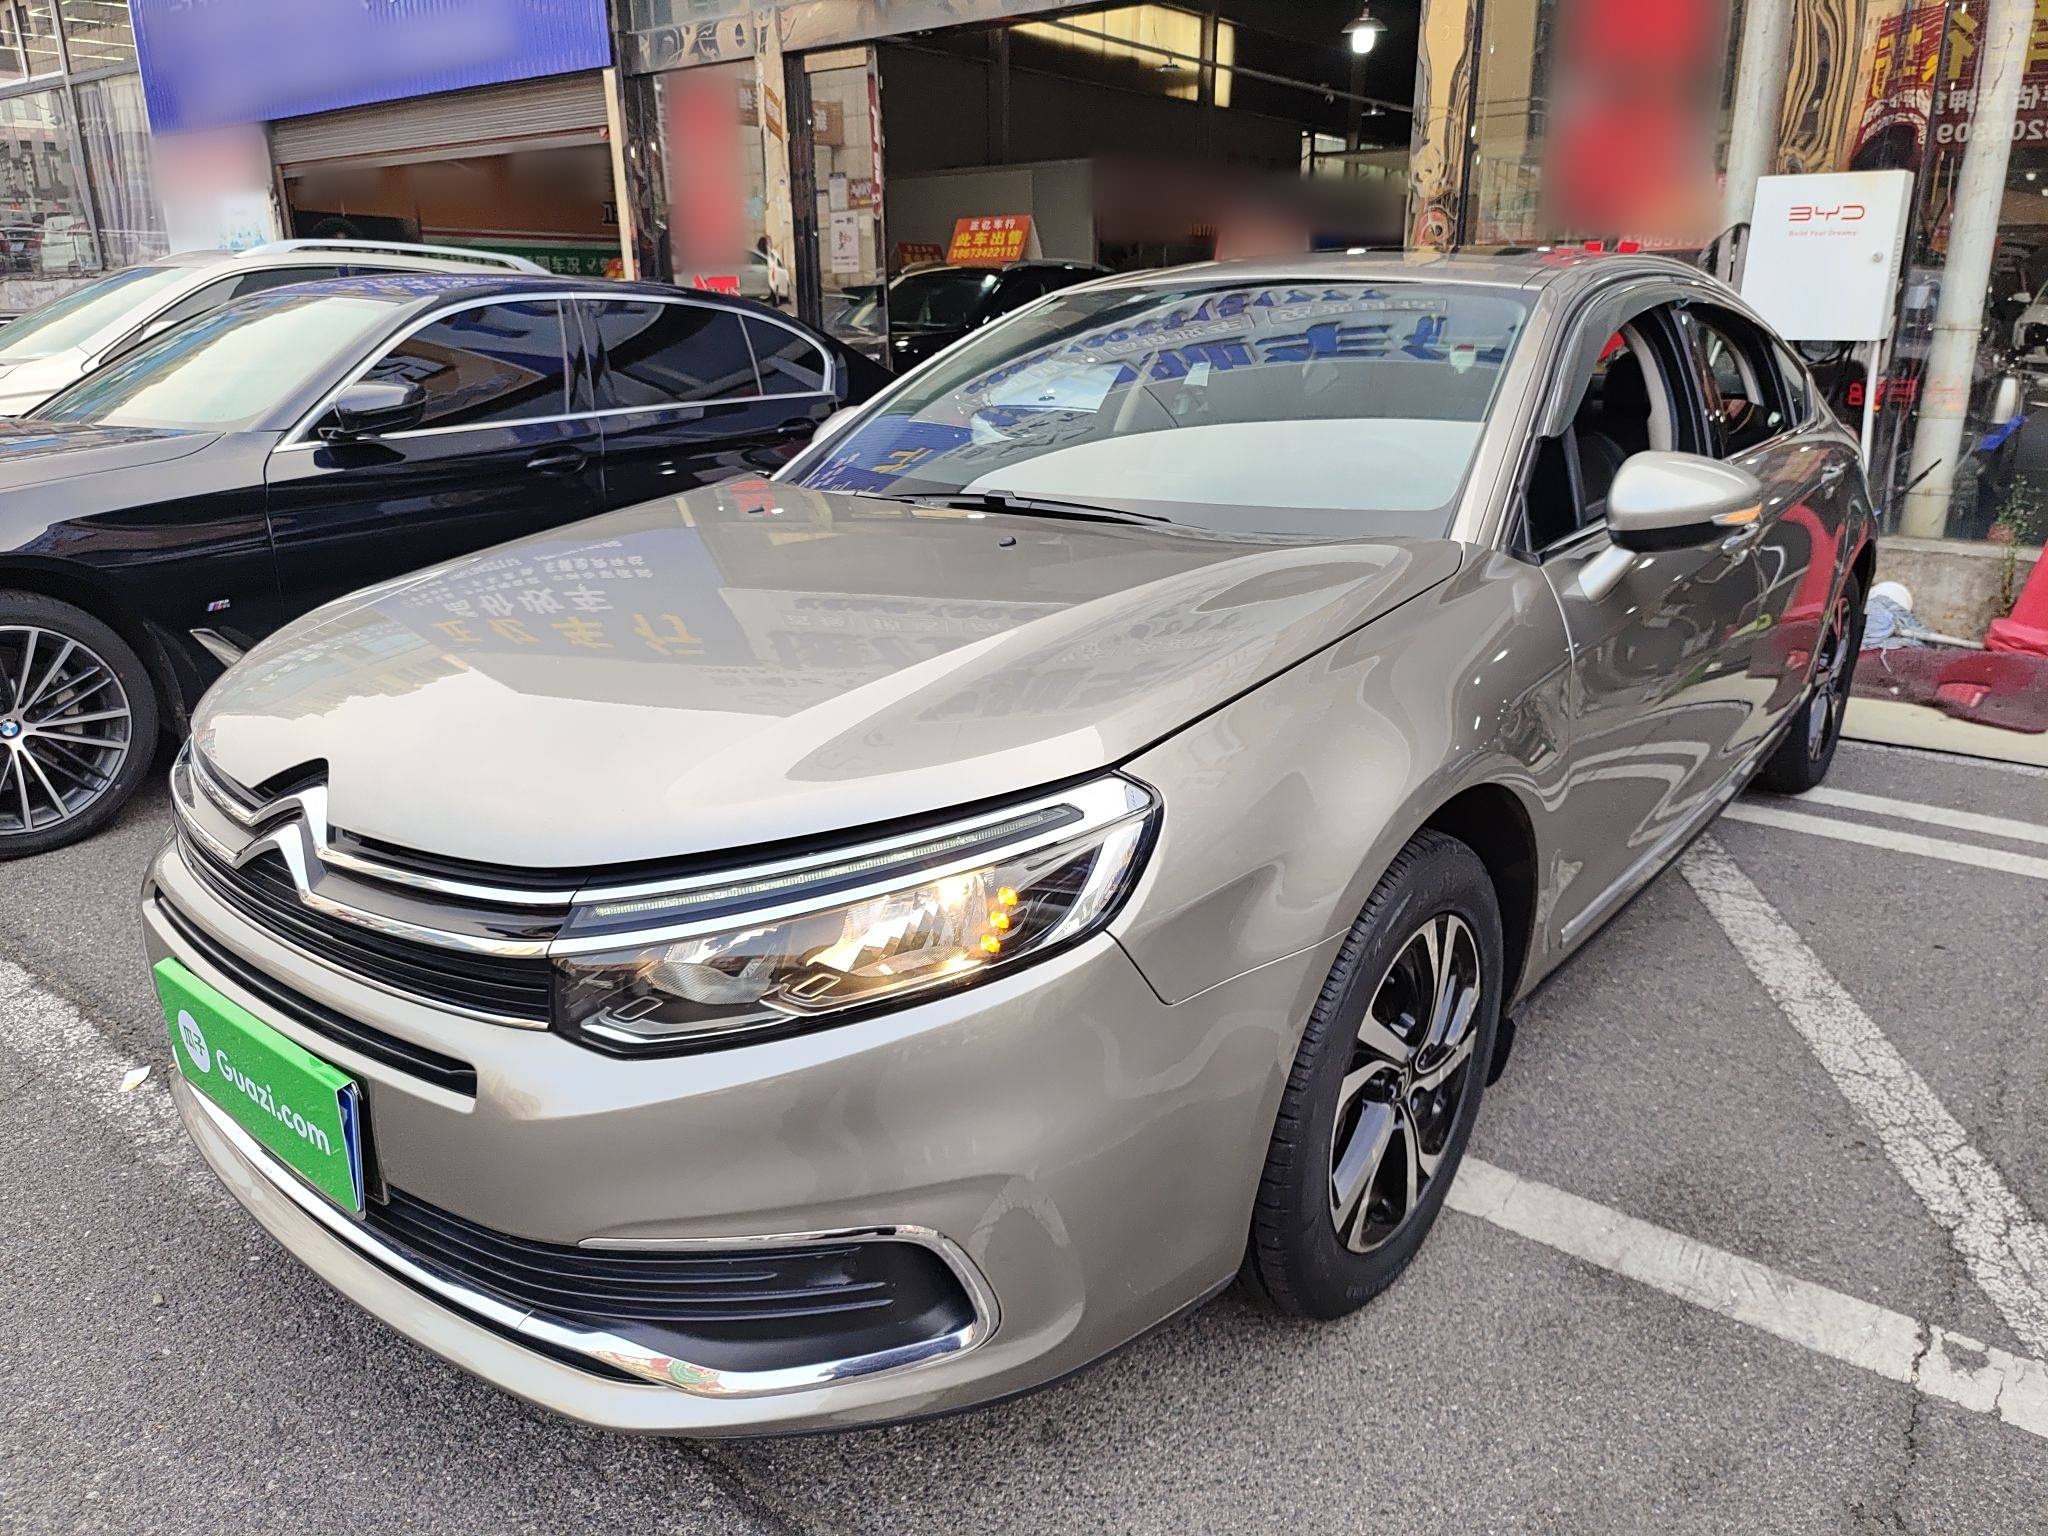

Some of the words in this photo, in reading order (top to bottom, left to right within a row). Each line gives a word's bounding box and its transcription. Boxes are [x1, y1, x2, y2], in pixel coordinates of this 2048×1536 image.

[1788, 205, 1865, 221] BYD
[954, 230, 1023, 247] 此车出售
[216, 1049, 331, 1156] Guazi.com
